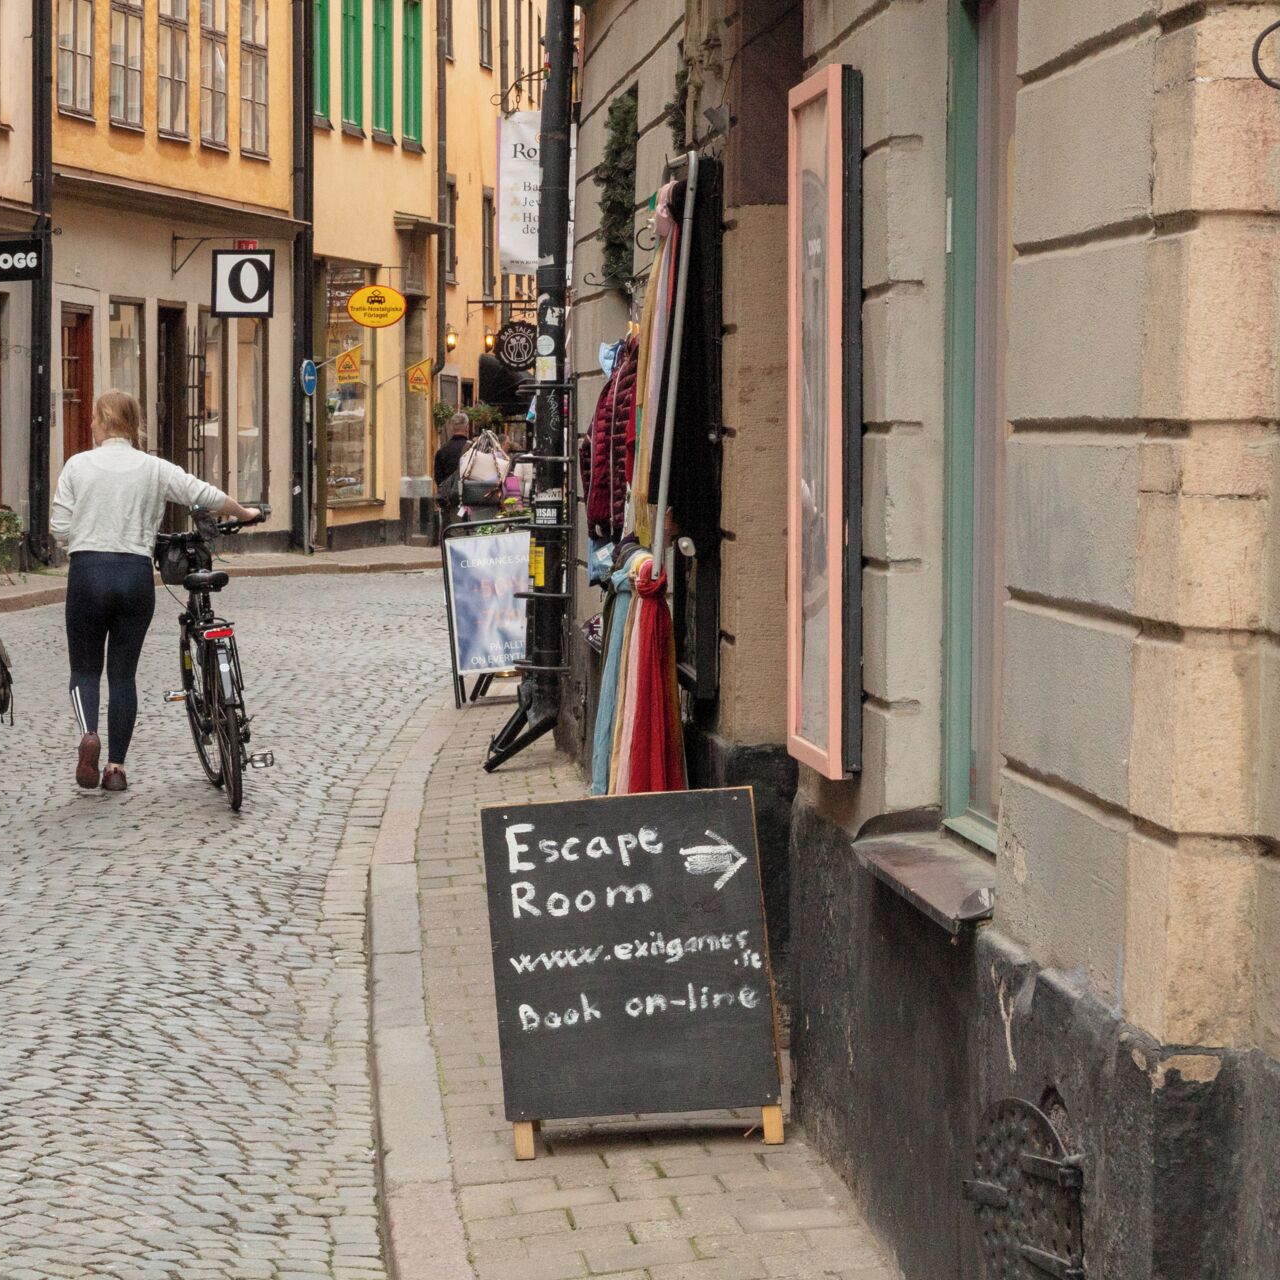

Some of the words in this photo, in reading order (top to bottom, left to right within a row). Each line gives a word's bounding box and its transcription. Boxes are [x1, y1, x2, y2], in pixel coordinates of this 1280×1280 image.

[500, 328, 514, 340] BAR
[460, 556, 513, 568] CLEARANCE
[471, 656, 485, 665] ON
[505, 823, 663, 873] Escape
[510, 880, 654, 919] Room
[518, 992, 602, 1033] Book
[624, 982, 760, 1018] on-line
